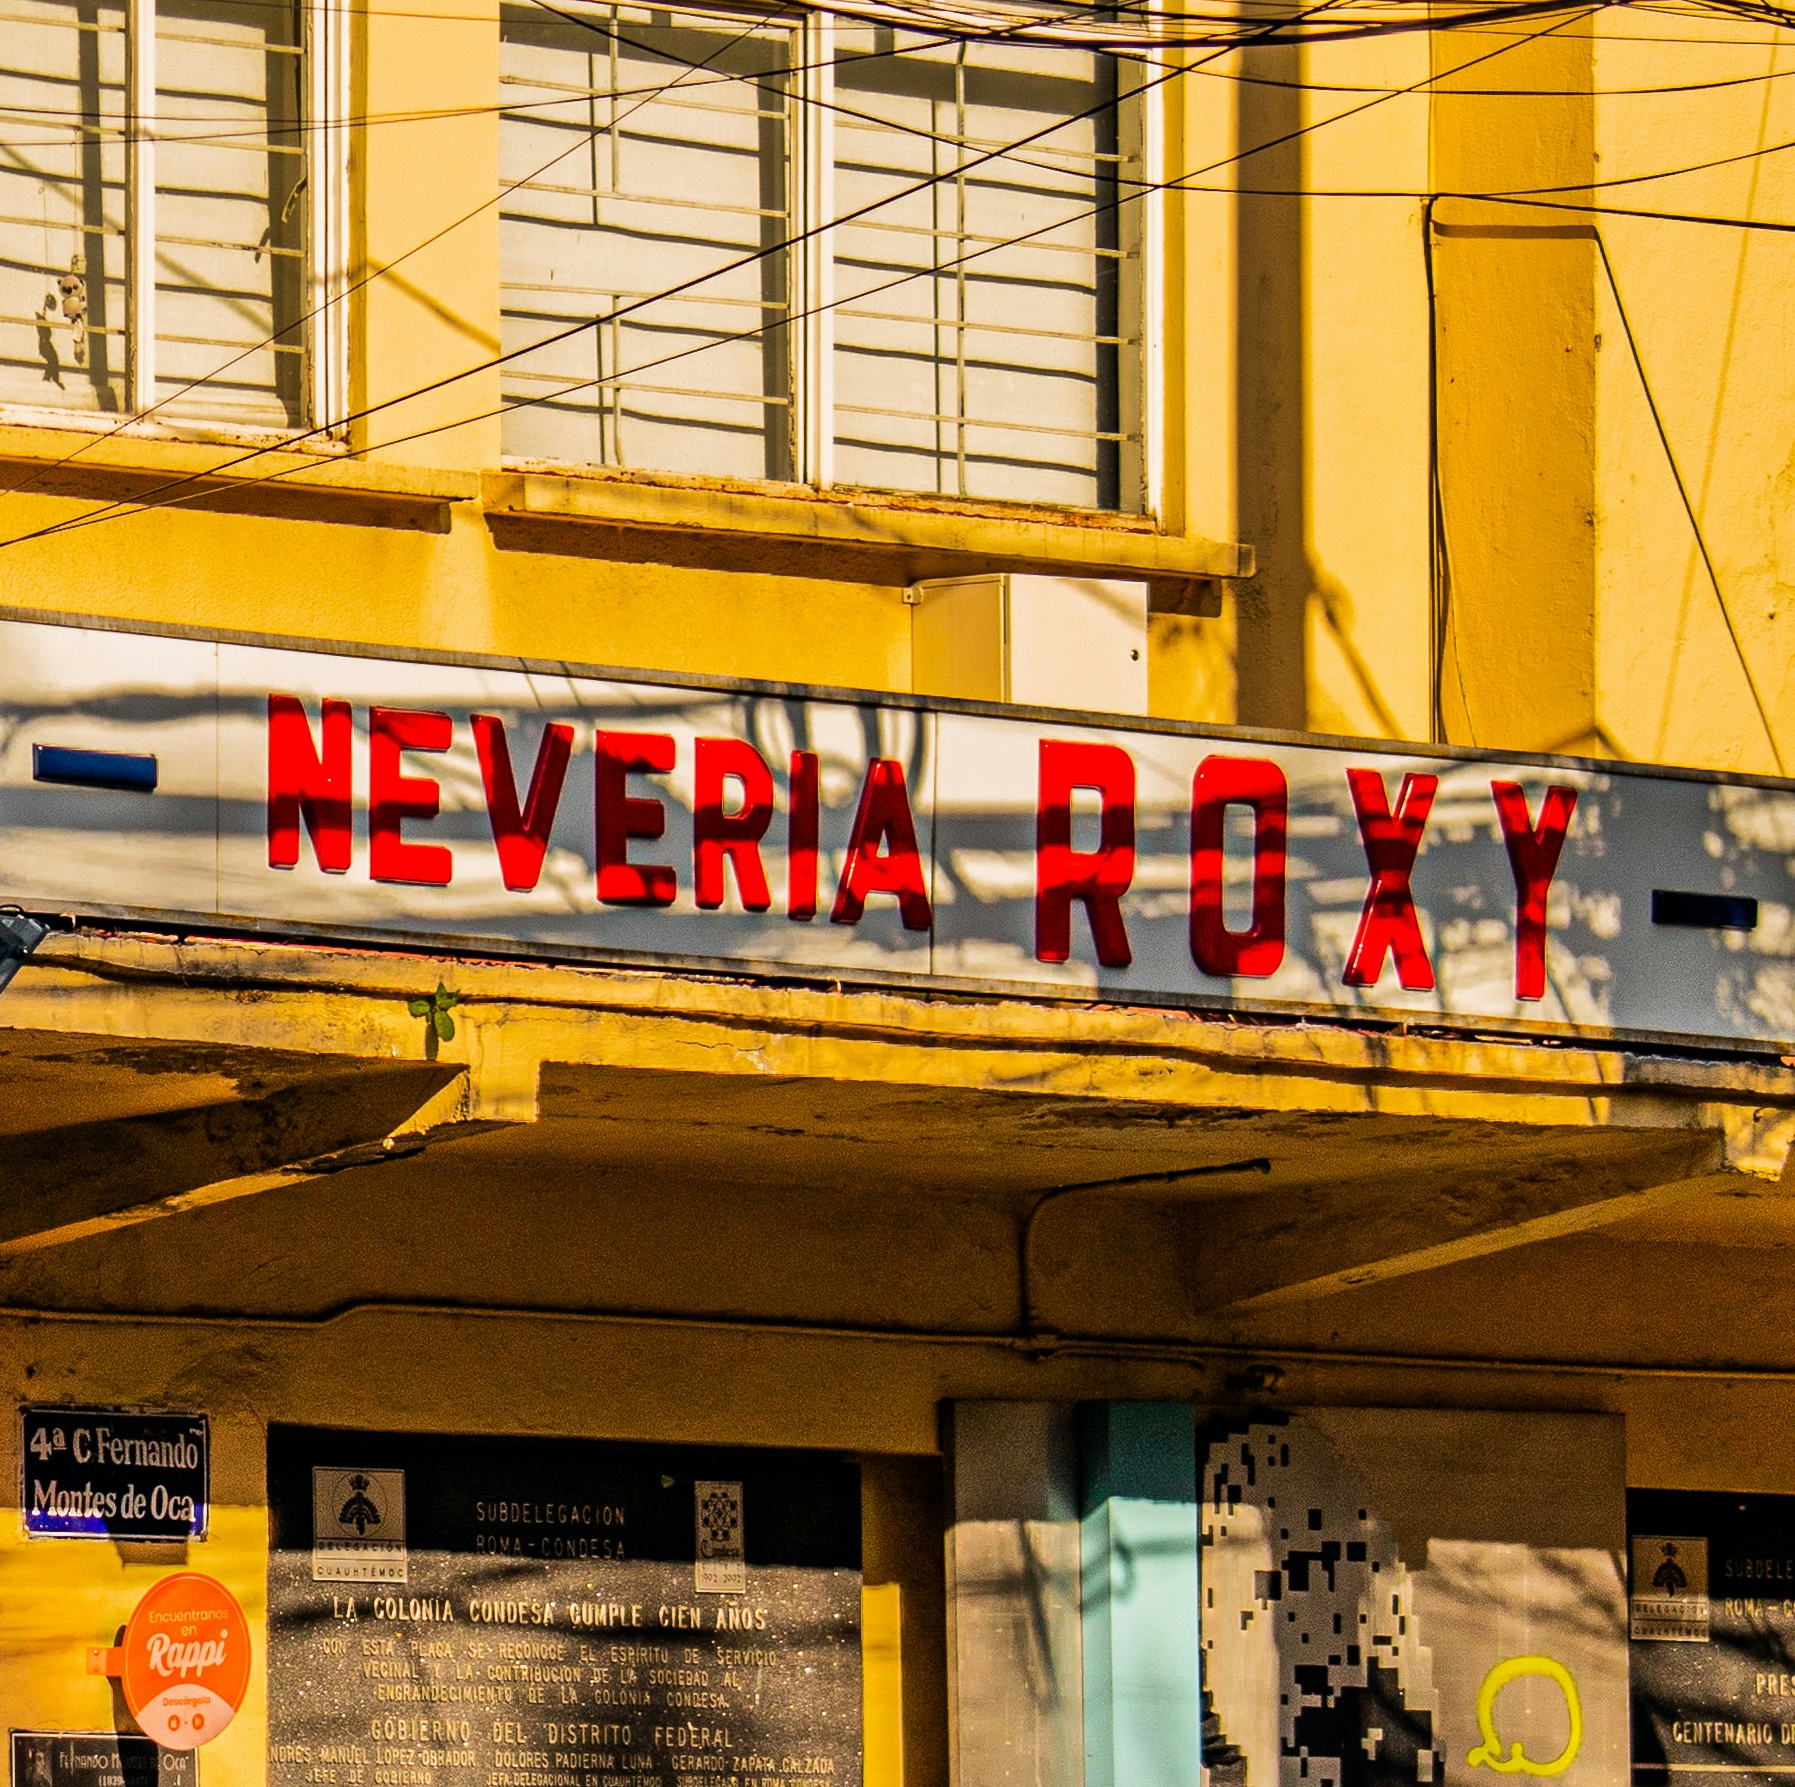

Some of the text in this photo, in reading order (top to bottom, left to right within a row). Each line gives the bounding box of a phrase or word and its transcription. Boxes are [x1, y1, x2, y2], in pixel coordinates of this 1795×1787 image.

[267, 694, 1579, 1002] NEVERIA ROXY
[72, 1427, 92, 1465] C
[95, 1426, 198, 1470] Fernando
[31, 1479, 197, 1523] Montes de Oca
[476, 1501, 626, 1527] SUBDELEGACION
[148, 1609, 230, 1624] Encuéntranos
[181, 1625, 197, 1636] en
[333, 1596, 767, 1632] LA COLONIA CONDESA CUMPLE CIEN AÑOS
[146, 1629, 228, 1679] Rappi
[370, 1719, 734, 1749] GOBIERNO DEL DISTRITO FEDERAL
[1671, 1720, 1773, 1746] CENTENARIO
